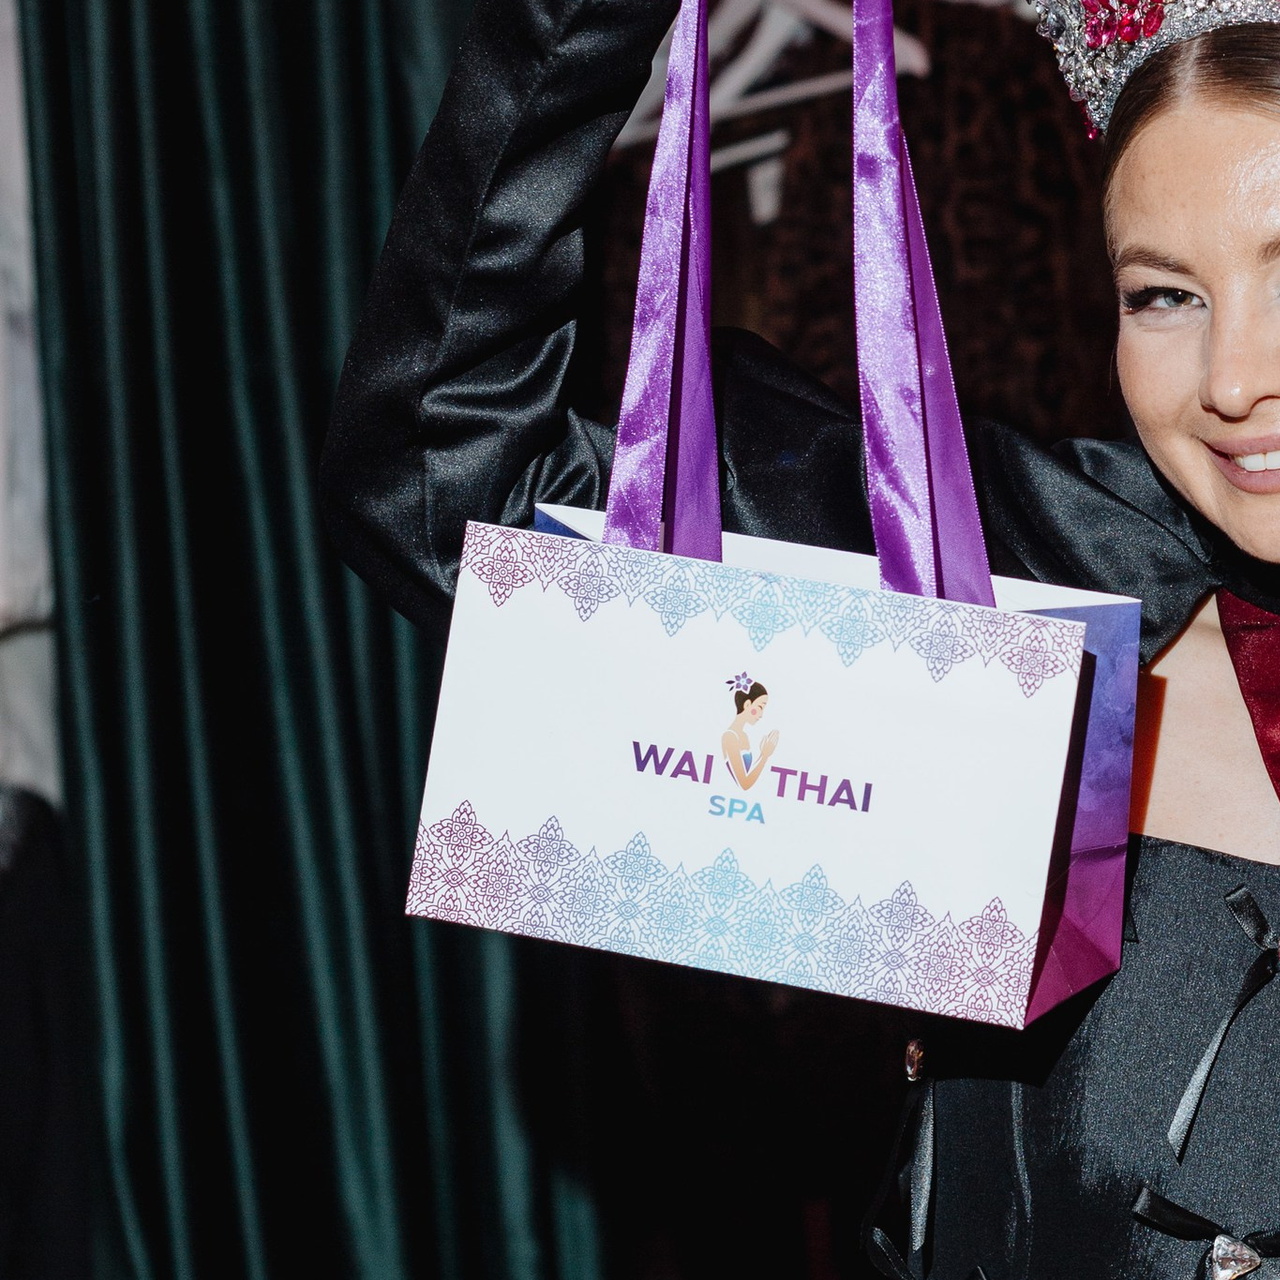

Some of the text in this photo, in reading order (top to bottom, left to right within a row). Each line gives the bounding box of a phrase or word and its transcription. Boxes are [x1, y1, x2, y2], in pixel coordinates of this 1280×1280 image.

[632, 741, 873, 813] WAI THAI
[708, 795, 766, 825] SPA
